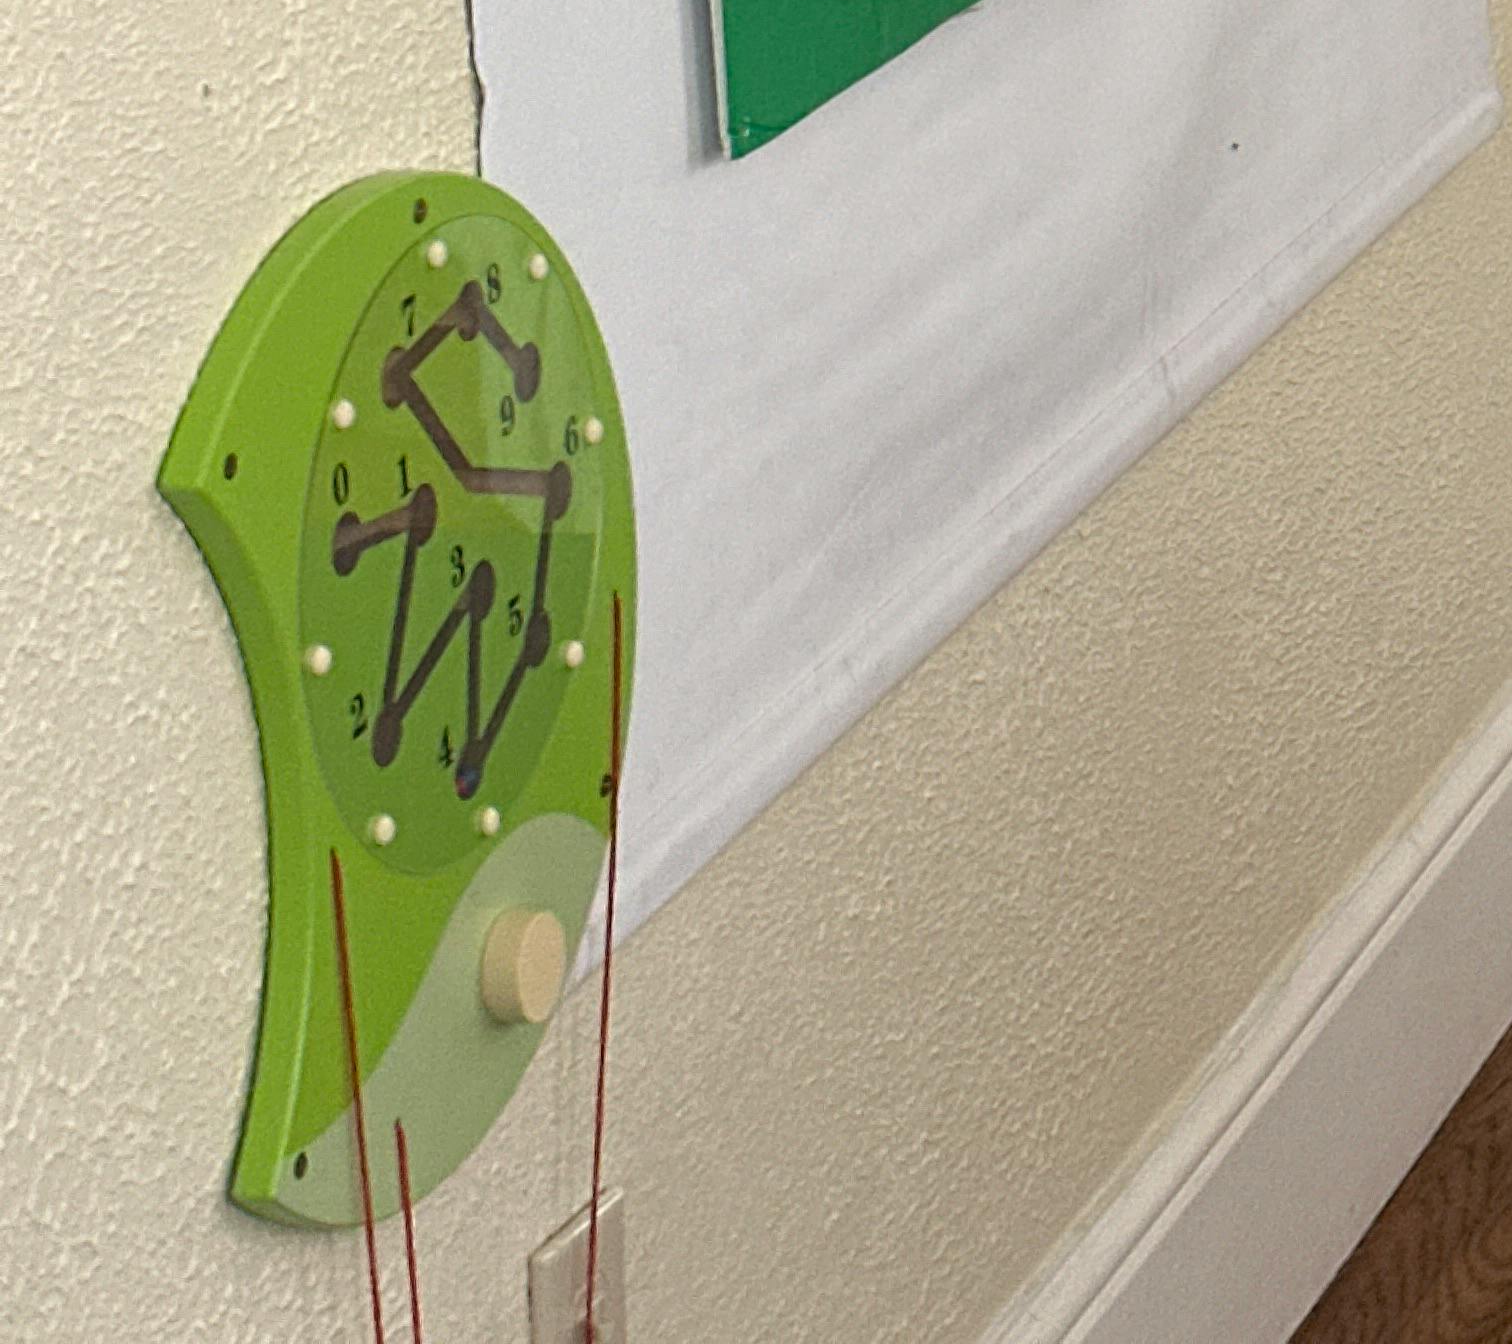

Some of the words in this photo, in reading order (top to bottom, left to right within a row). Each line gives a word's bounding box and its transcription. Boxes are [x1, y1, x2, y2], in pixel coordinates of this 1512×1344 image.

[485, 263, 501, 306] 8
[401, 293, 419, 337] 7
[500, 395, 515, 436] 9
[563, 414, 579, 456] 6
[332, 463, 350, 506] 0
[397, 454, 413, 500] 1
[450, 544, 466, 587] 3
[508, 595, 524, 637] 5
[350, 693, 368, 739] 2
[438, 725, 455, 768] 4
